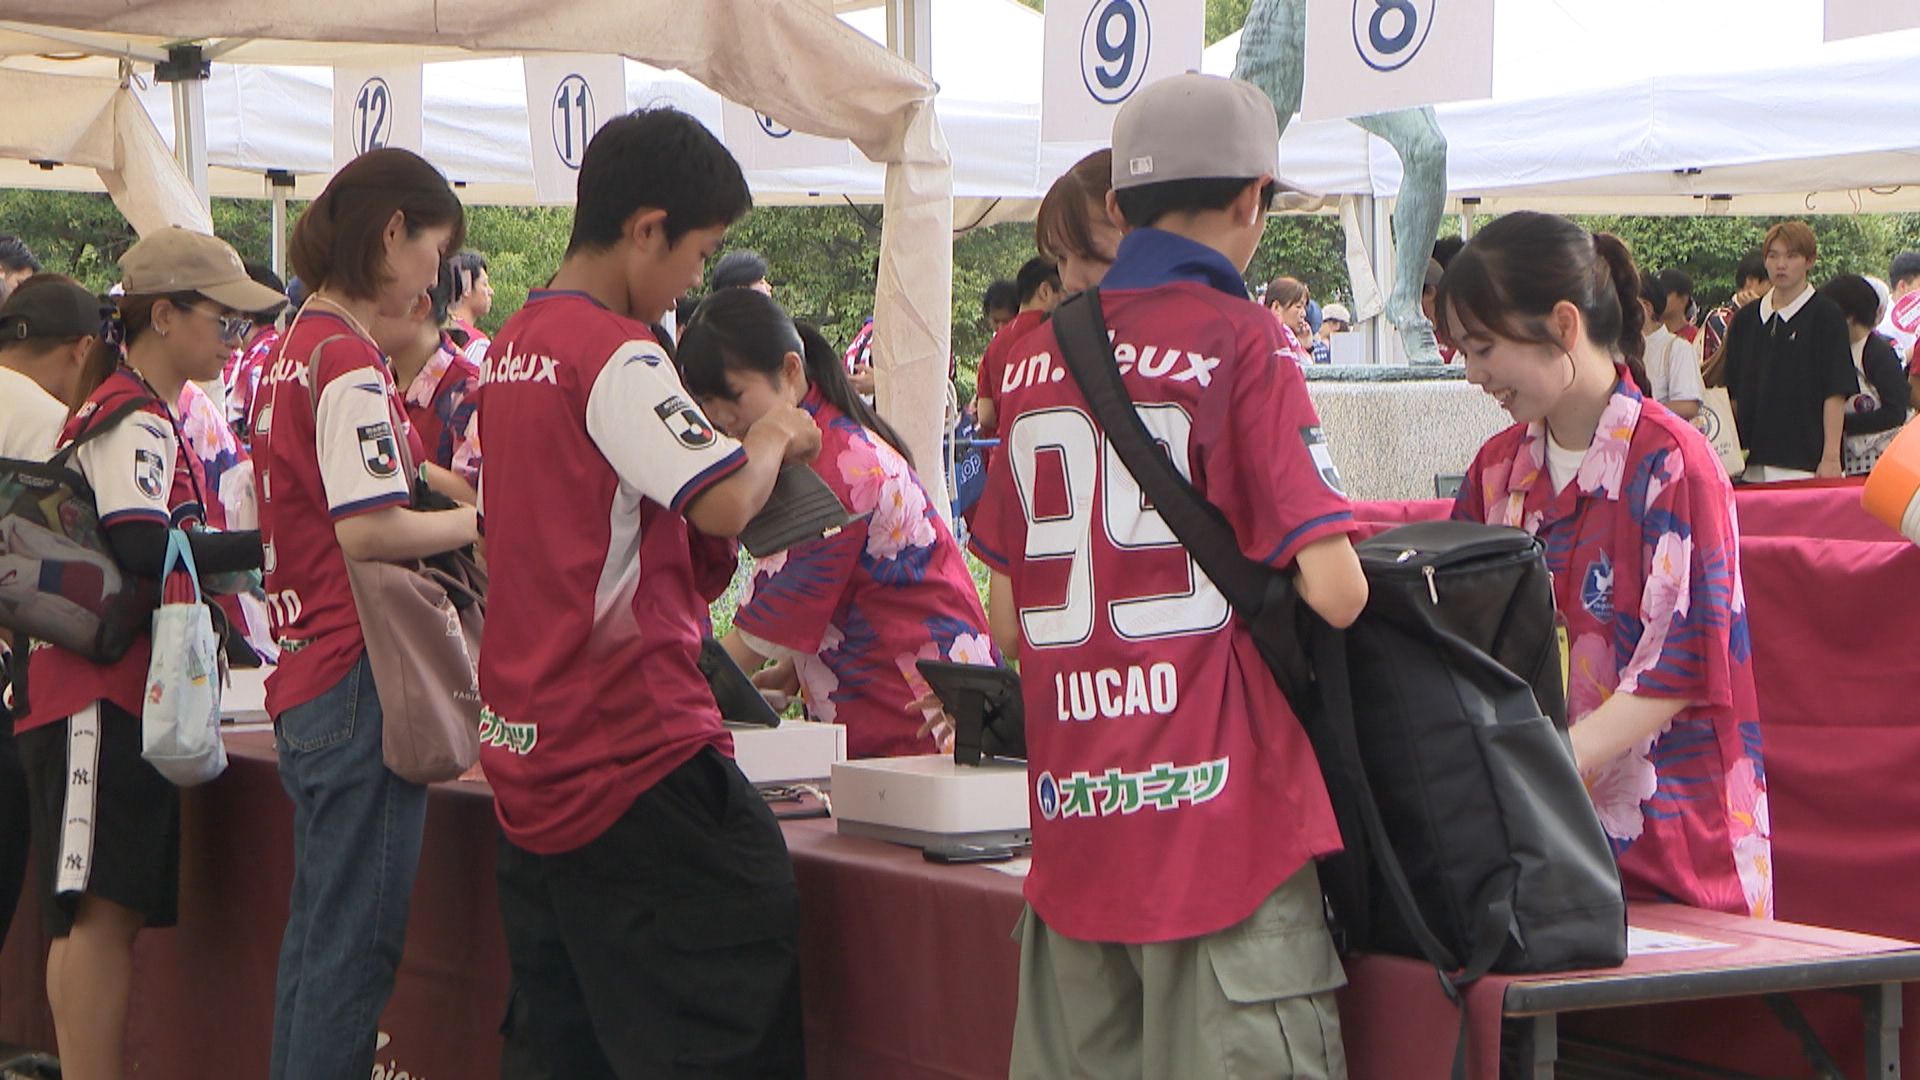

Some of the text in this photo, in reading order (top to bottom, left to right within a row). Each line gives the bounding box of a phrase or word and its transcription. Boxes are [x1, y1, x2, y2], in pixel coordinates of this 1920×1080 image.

[1095, 0, 1136, 89] 9
[358, 85, 386, 153] 12
[558, 84, 588, 159] 11
[1001, 329, 1221, 393] un.eux
[1009, 402, 1233, 650] 99
[1055, 662, 1178, 721] LUCAO
[1058, 756, 1230, 820] オカネツ
